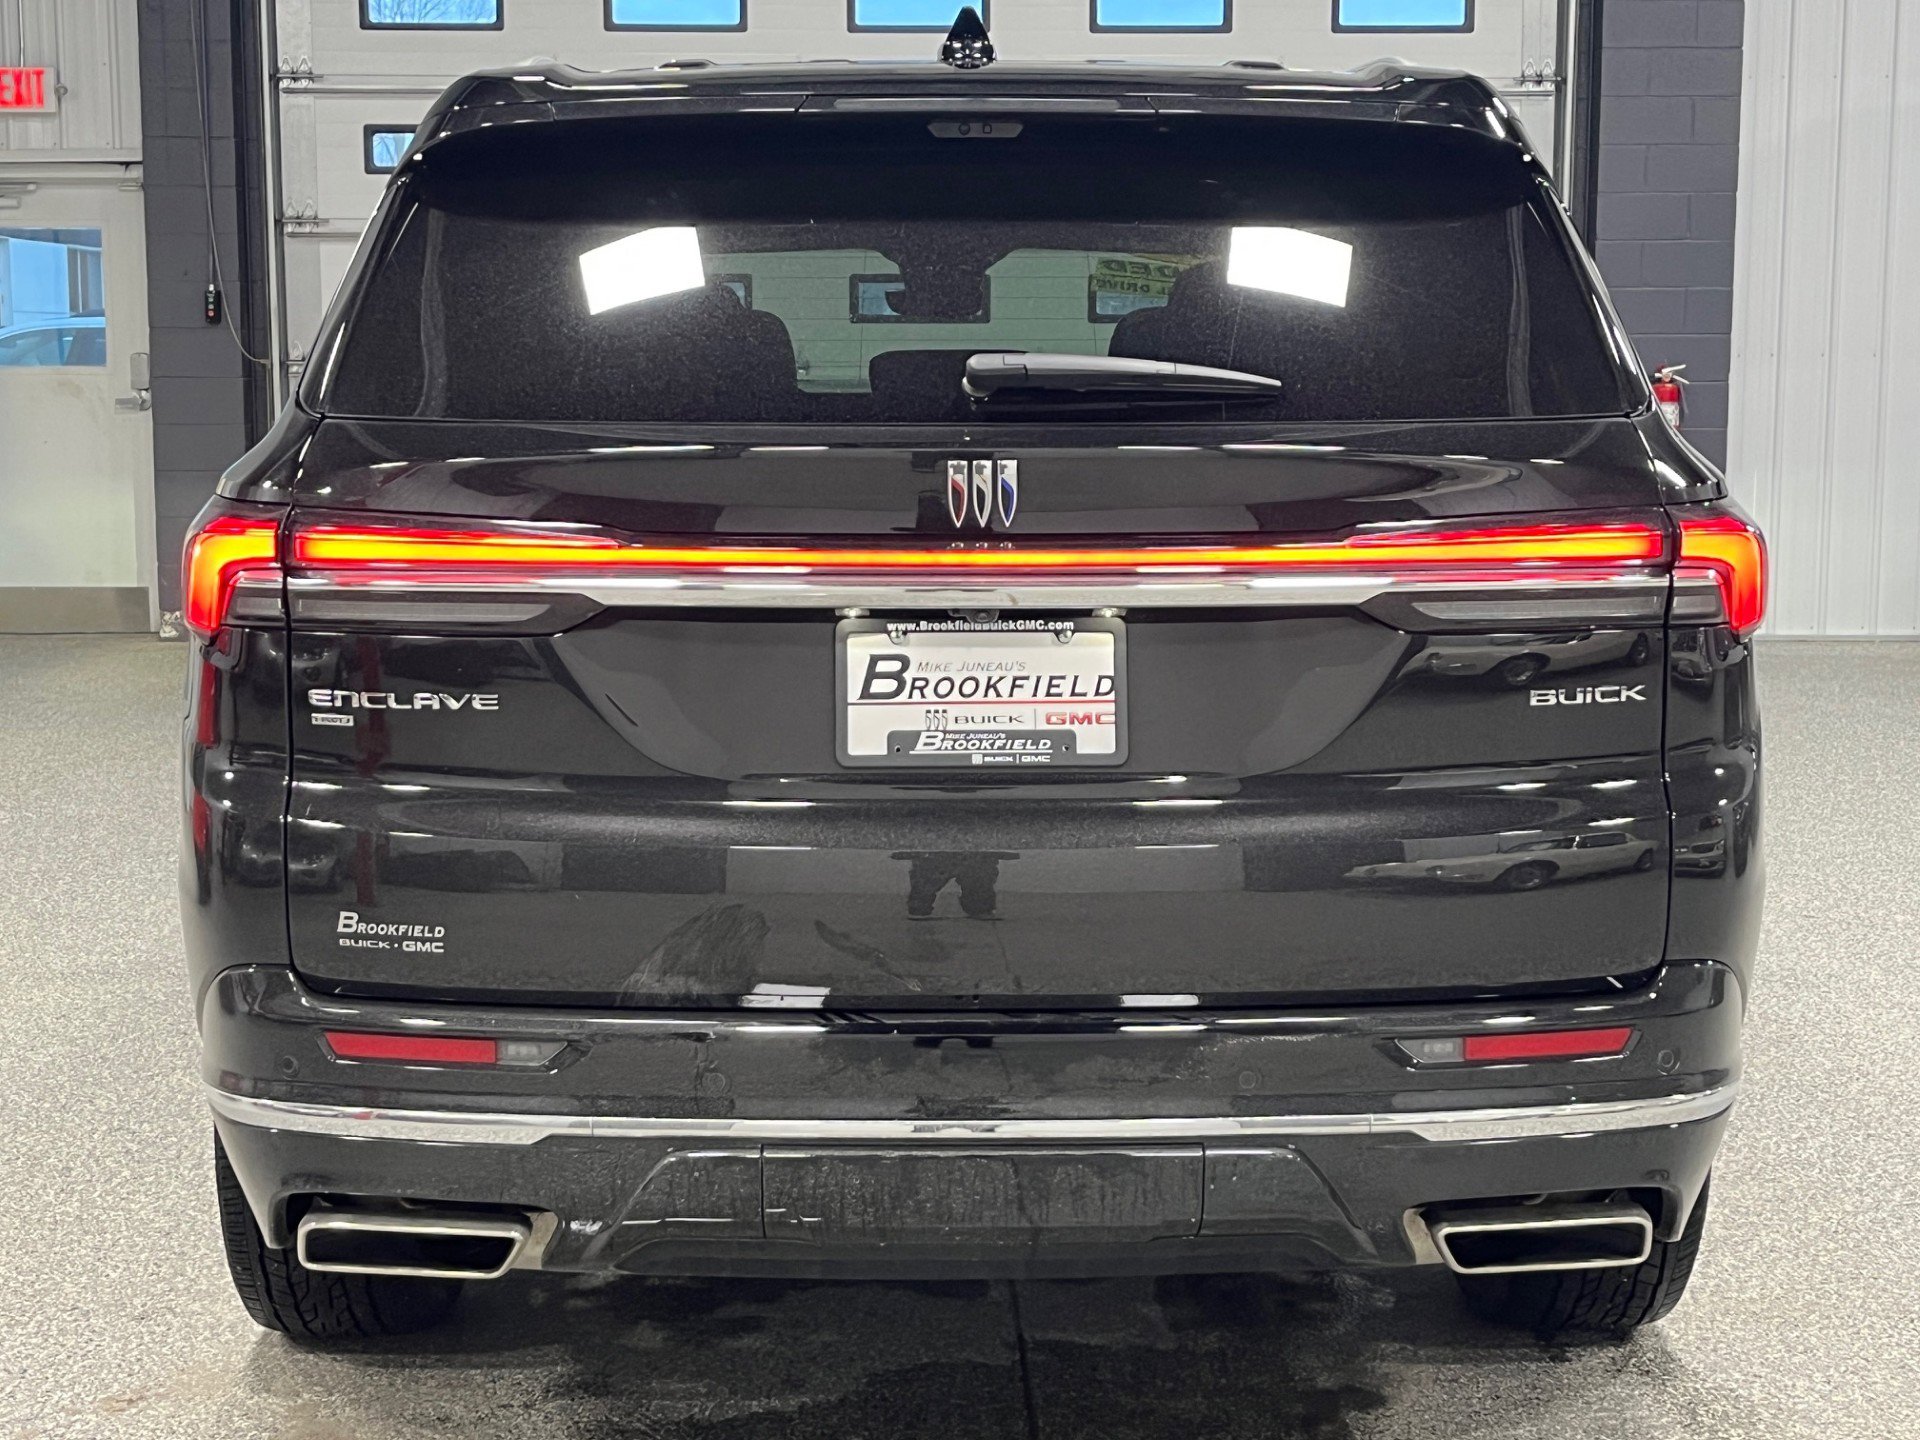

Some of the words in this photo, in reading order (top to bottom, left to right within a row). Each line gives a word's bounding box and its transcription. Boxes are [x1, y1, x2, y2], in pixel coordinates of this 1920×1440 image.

[0, 68, 44, 108] EXIT
[857, 653, 1115, 700] BROOKFIELD
[916, 661, 952, 673] MIKE
[957, 661, 1026, 673] JUNEAU'S
[308, 689, 499, 710] ENCLAVE
[1530, 685, 1647, 706] BUICK
[954, 714, 1025, 725] BUICK
[1045, 712, 1115, 725] GMC
[914, 731, 1051, 751] BROOKFIELD
[337, 911, 445, 938] BROOKFIELD
[339, 938, 391, 949] BUICK
[402, 941, 444, 953] GMC
